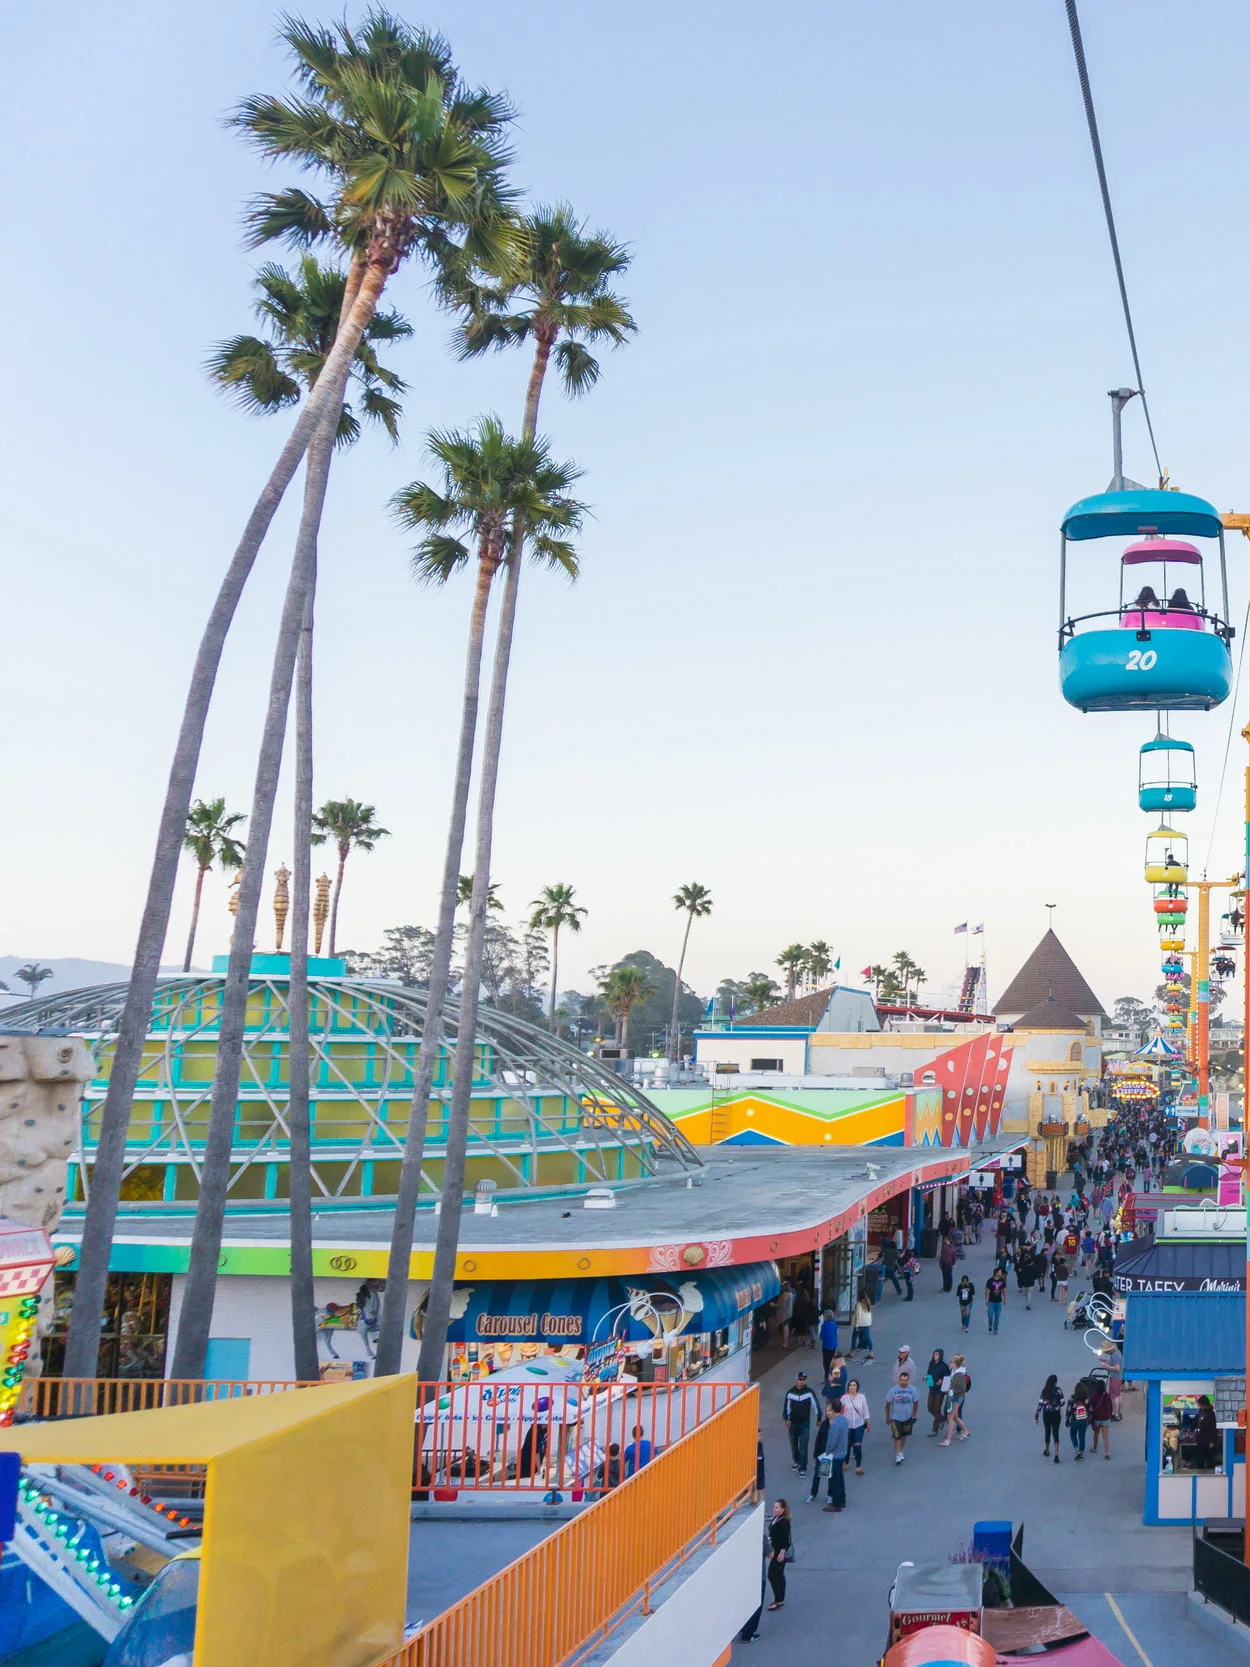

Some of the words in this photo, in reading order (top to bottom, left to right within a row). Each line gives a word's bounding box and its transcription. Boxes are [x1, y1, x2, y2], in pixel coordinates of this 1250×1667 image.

[1125, 650, 1158, 671] 20
[1068, 1239, 1076, 1247] 10
[476, 1312, 537, 1336] Carousel
[540, 1312, 582, 1335] Cones
